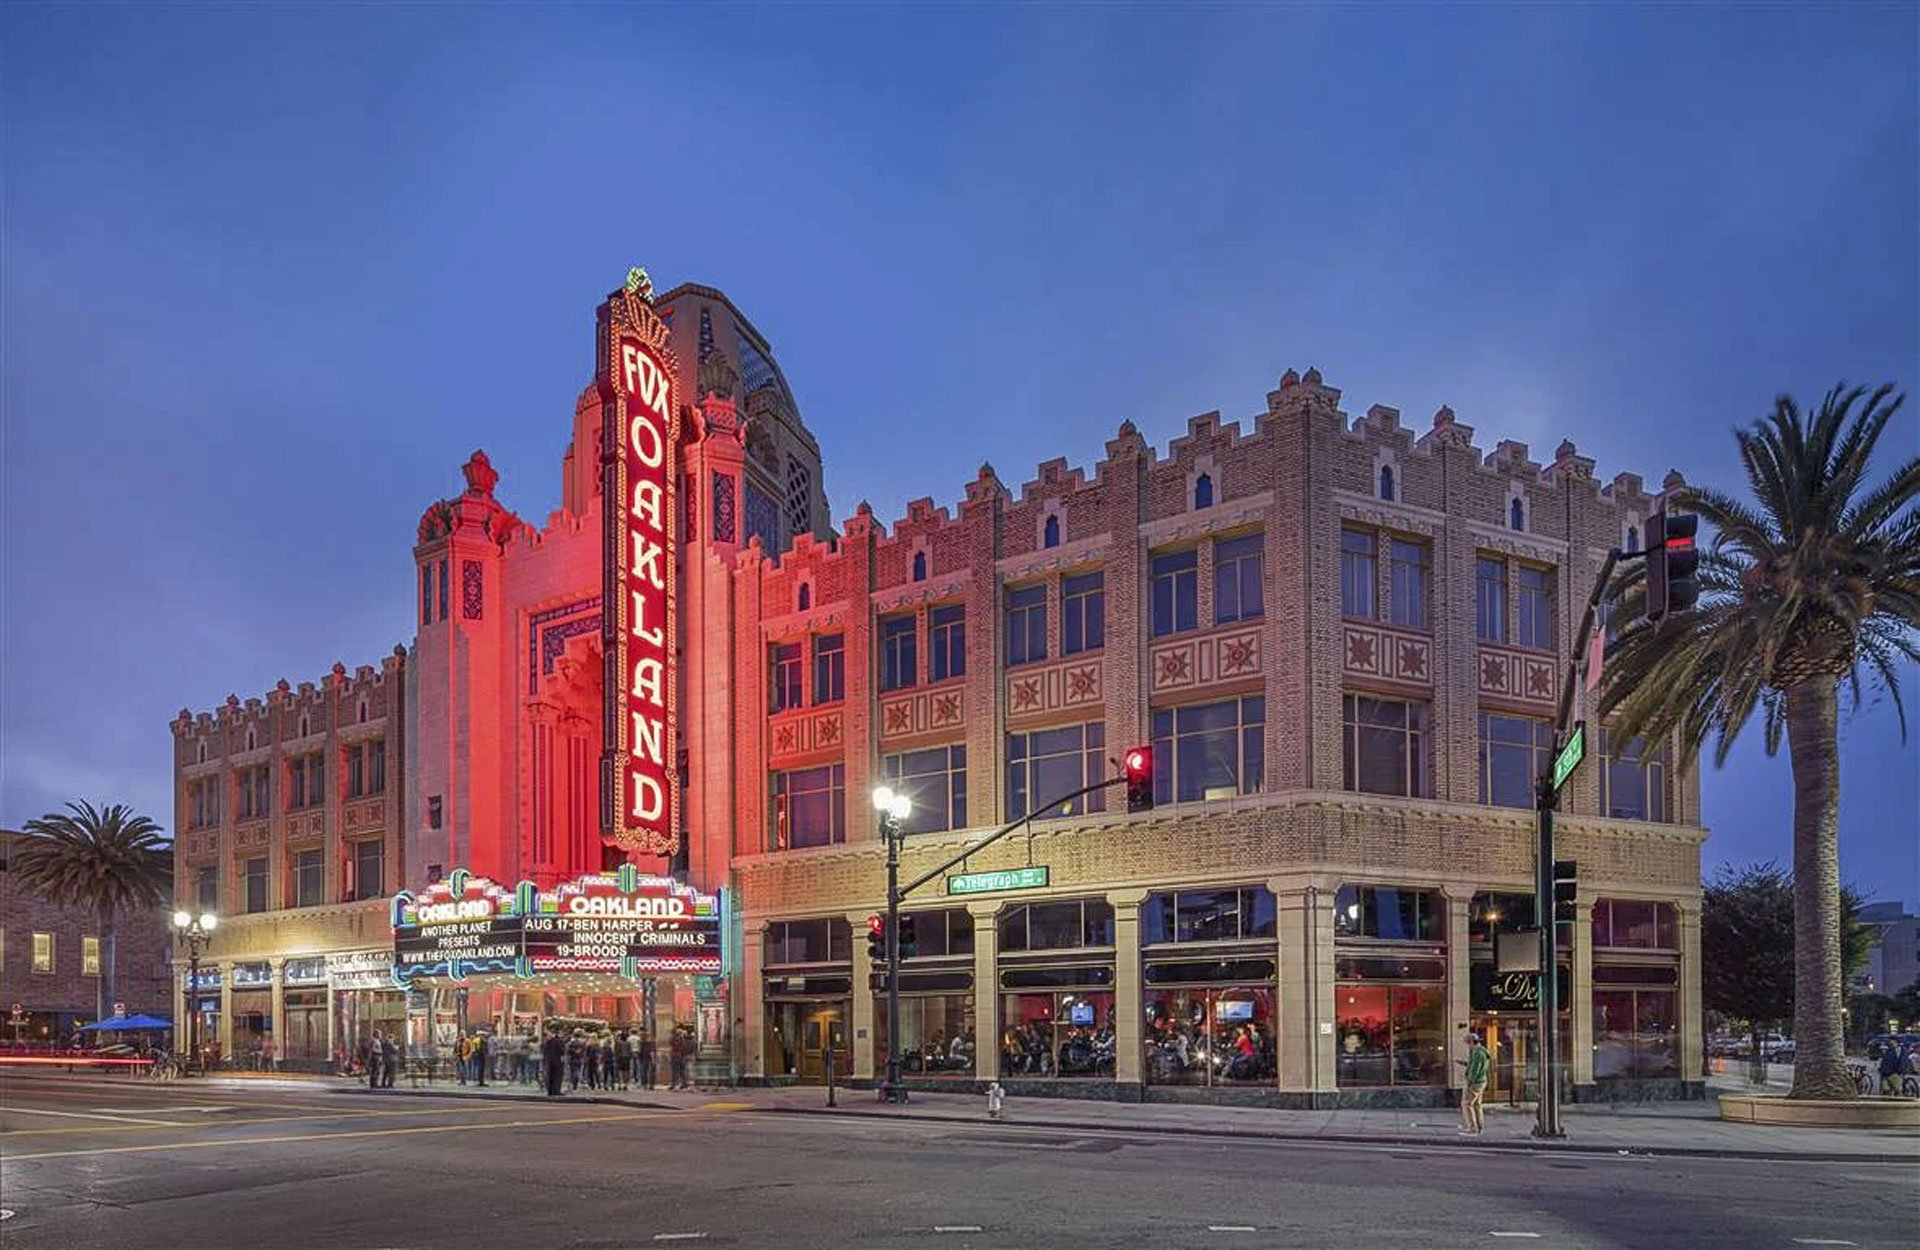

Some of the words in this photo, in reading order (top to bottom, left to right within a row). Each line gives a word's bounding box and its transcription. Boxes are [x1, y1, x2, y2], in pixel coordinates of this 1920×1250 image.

[622, 344, 670, 421] FOX
[631, 416, 665, 821] OAKLAND
[418, 900, 491, 921] OAKLAND
[570, 896, 684, 916] OAKLAND
[420, 923, 458, 937] ANOTHER
[459, 920, 493, 934] PLANET
[524, 919, 553, 931] AUG
[602, 920, 654, 931] HARPER
[438, 935, 481, 948] PRESENTS
[573, 932, 635, 944] INNOCENT
[640, 933, 706, 945] CRIMINALS
[402, 945, 516, 962] WWW.THEFOXOAKLAND.COM
